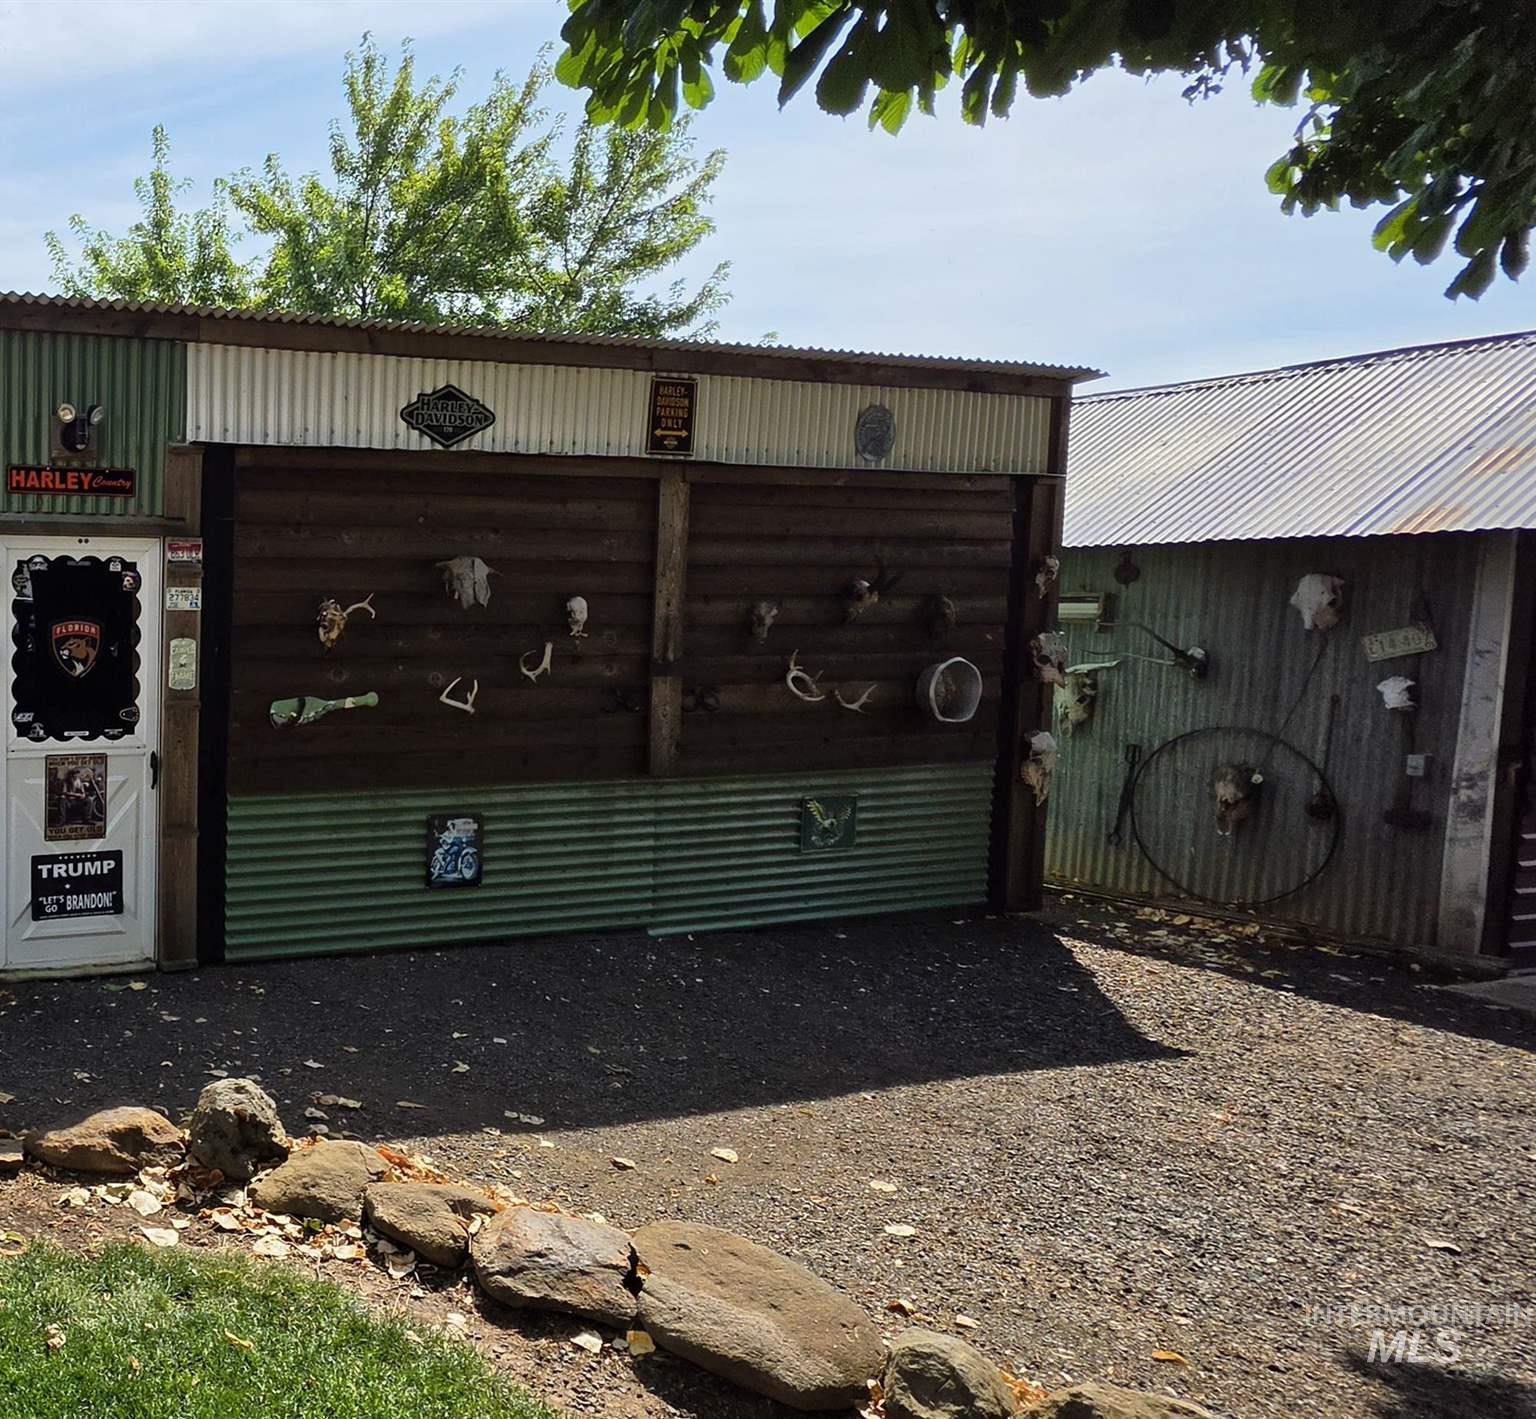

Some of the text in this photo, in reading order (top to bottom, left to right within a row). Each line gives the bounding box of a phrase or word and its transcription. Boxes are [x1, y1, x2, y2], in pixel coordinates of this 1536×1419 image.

[656, 407, 688, 418] PARKING
[414, 411, 484, 427] DAVIDSON
[660, 418, 682, 428] ONLY
[11, 470, 132, 490] HARLEY Country
[86, 825, 103, 833] OLD
[37, 860, 115, 878] TRUMP
[45, 904, 58, 913] GO
